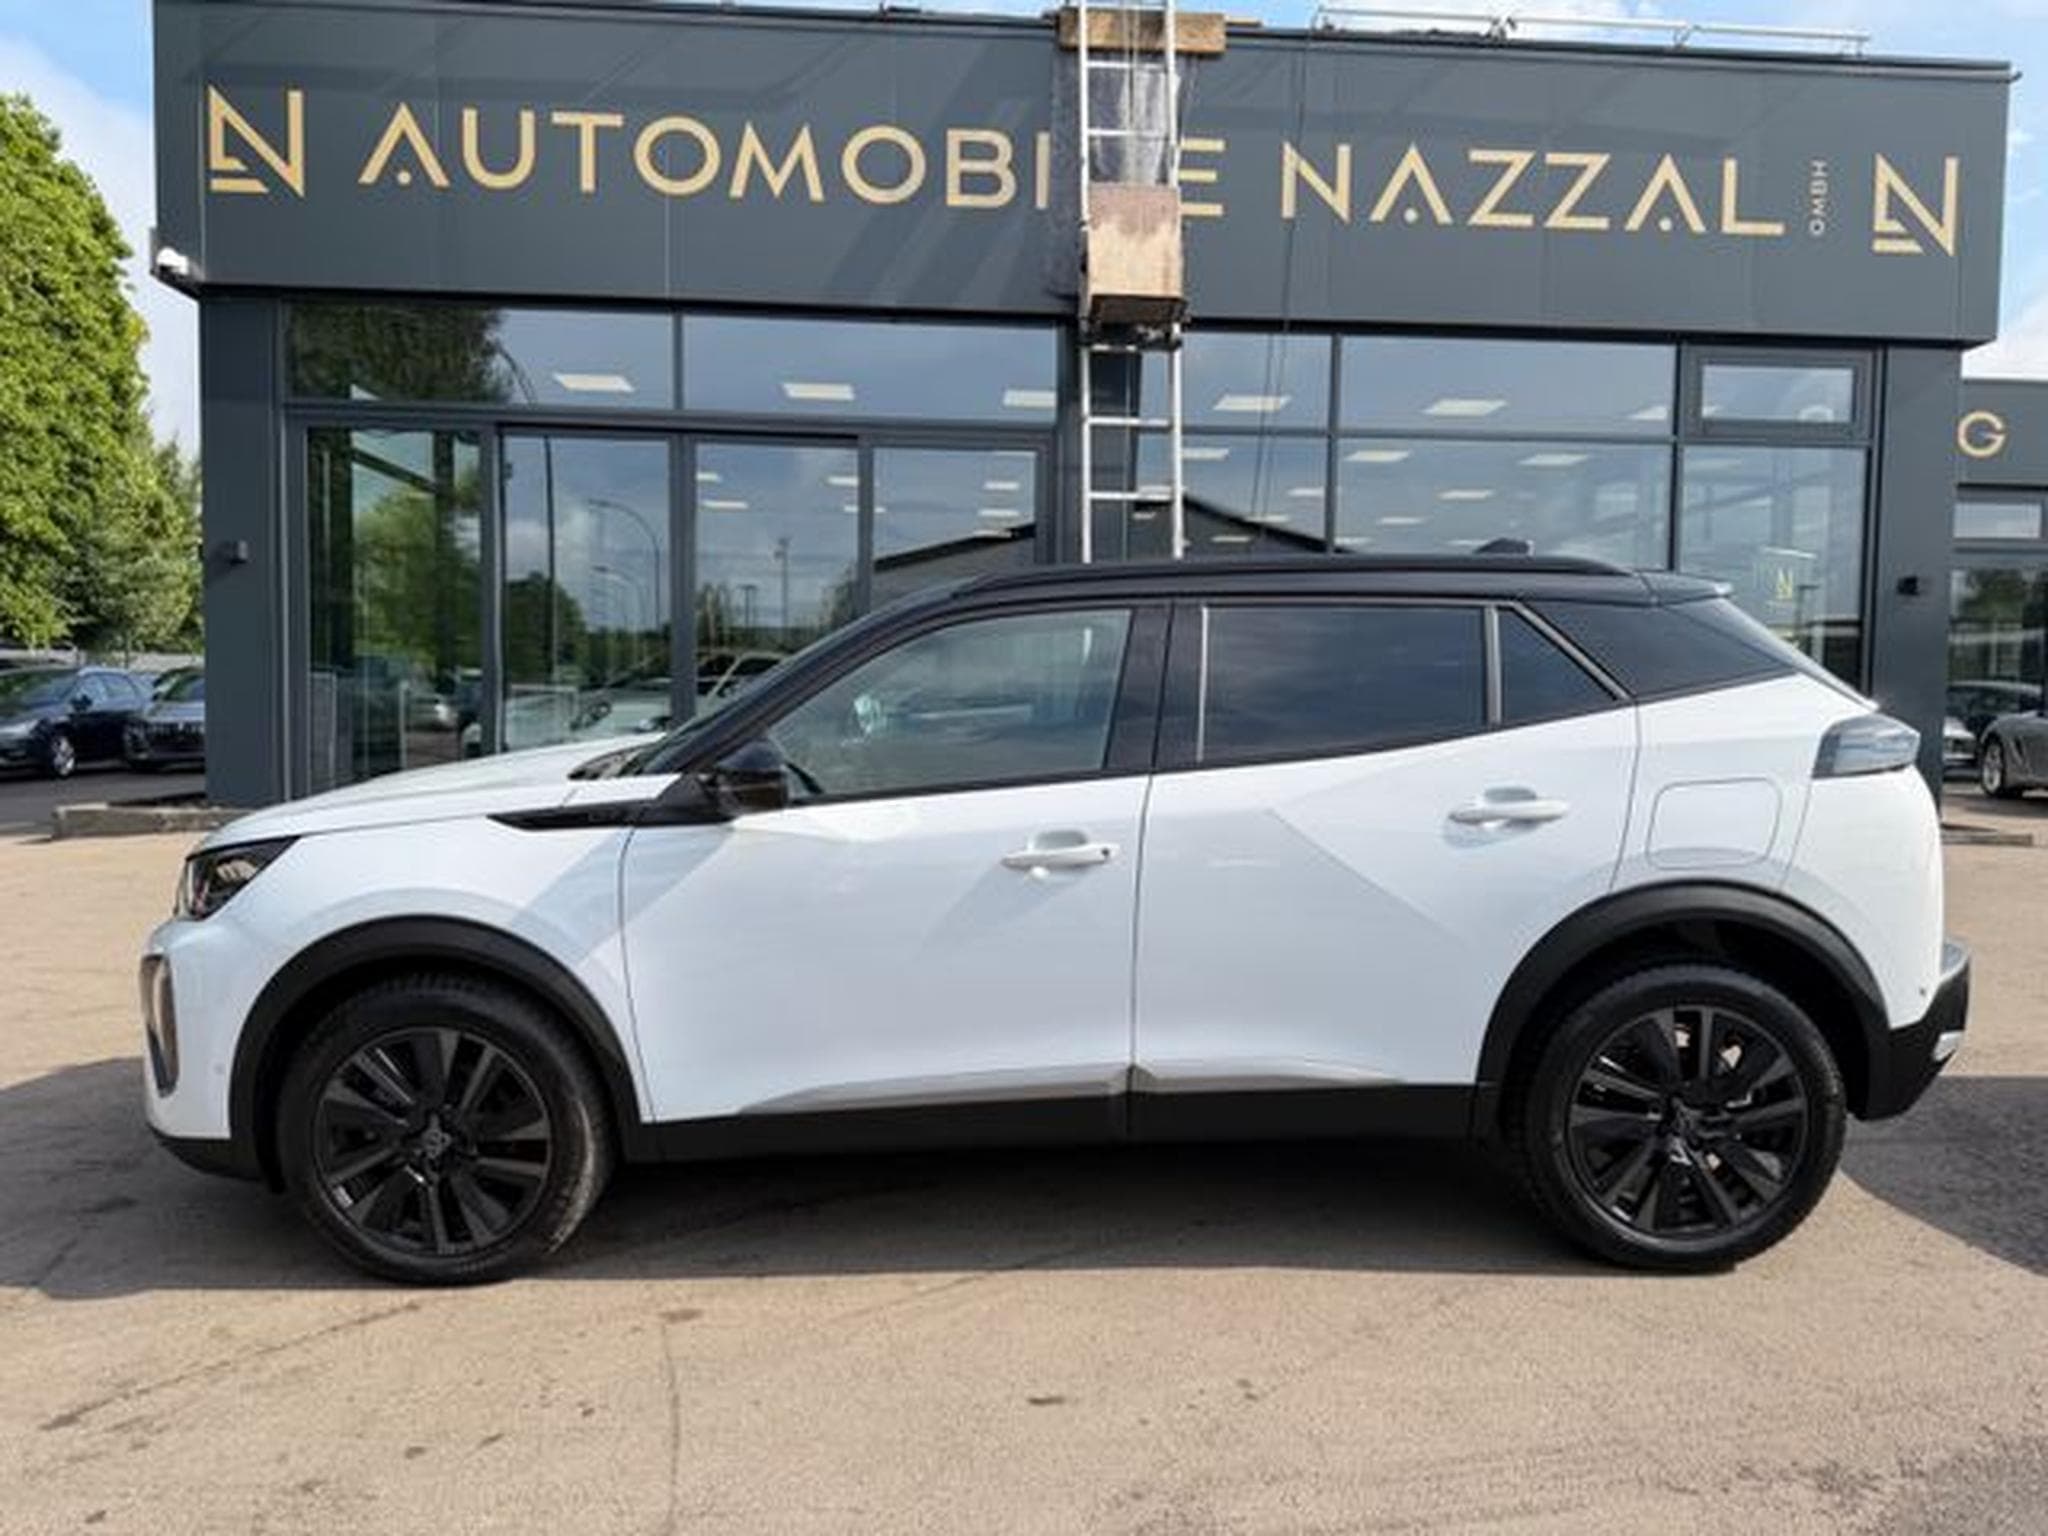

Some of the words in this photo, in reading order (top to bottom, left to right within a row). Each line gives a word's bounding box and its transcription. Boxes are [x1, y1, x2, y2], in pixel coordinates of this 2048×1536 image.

[358, 102, 1226, 217] AUTOMOBIE
[1280, 141, 1787, 238] NAZZAL
[1956, 410, 2006, 459] G
